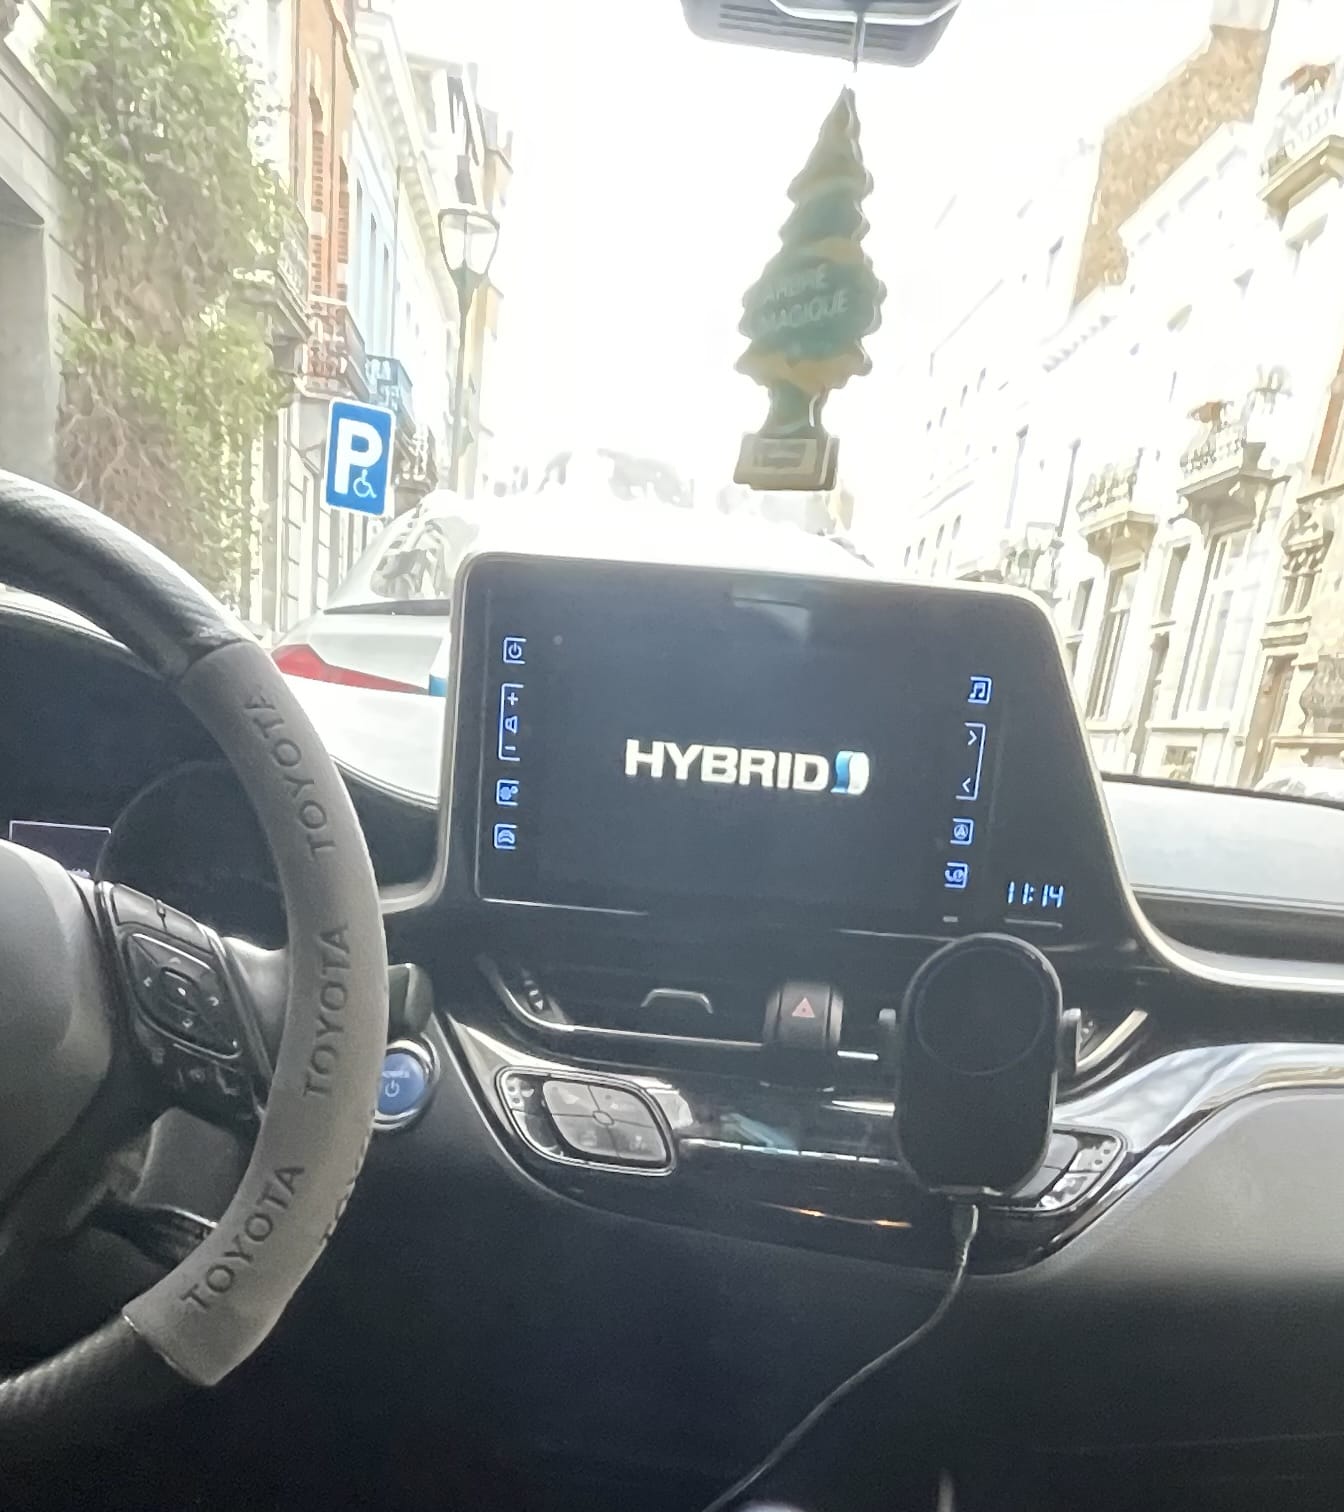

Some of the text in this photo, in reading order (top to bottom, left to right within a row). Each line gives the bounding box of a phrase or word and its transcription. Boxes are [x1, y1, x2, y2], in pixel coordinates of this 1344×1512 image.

[334, 417, 383, 495] P
[244, 692, 336, 861] TOYOTA
[625, 739, 830, 791] HYBRID
[1007, 880, 1064, 908] 11:14
[304, 923, 351, 1097] TOYOTA
[180, 1166, 305, 1308] TOYOTA
